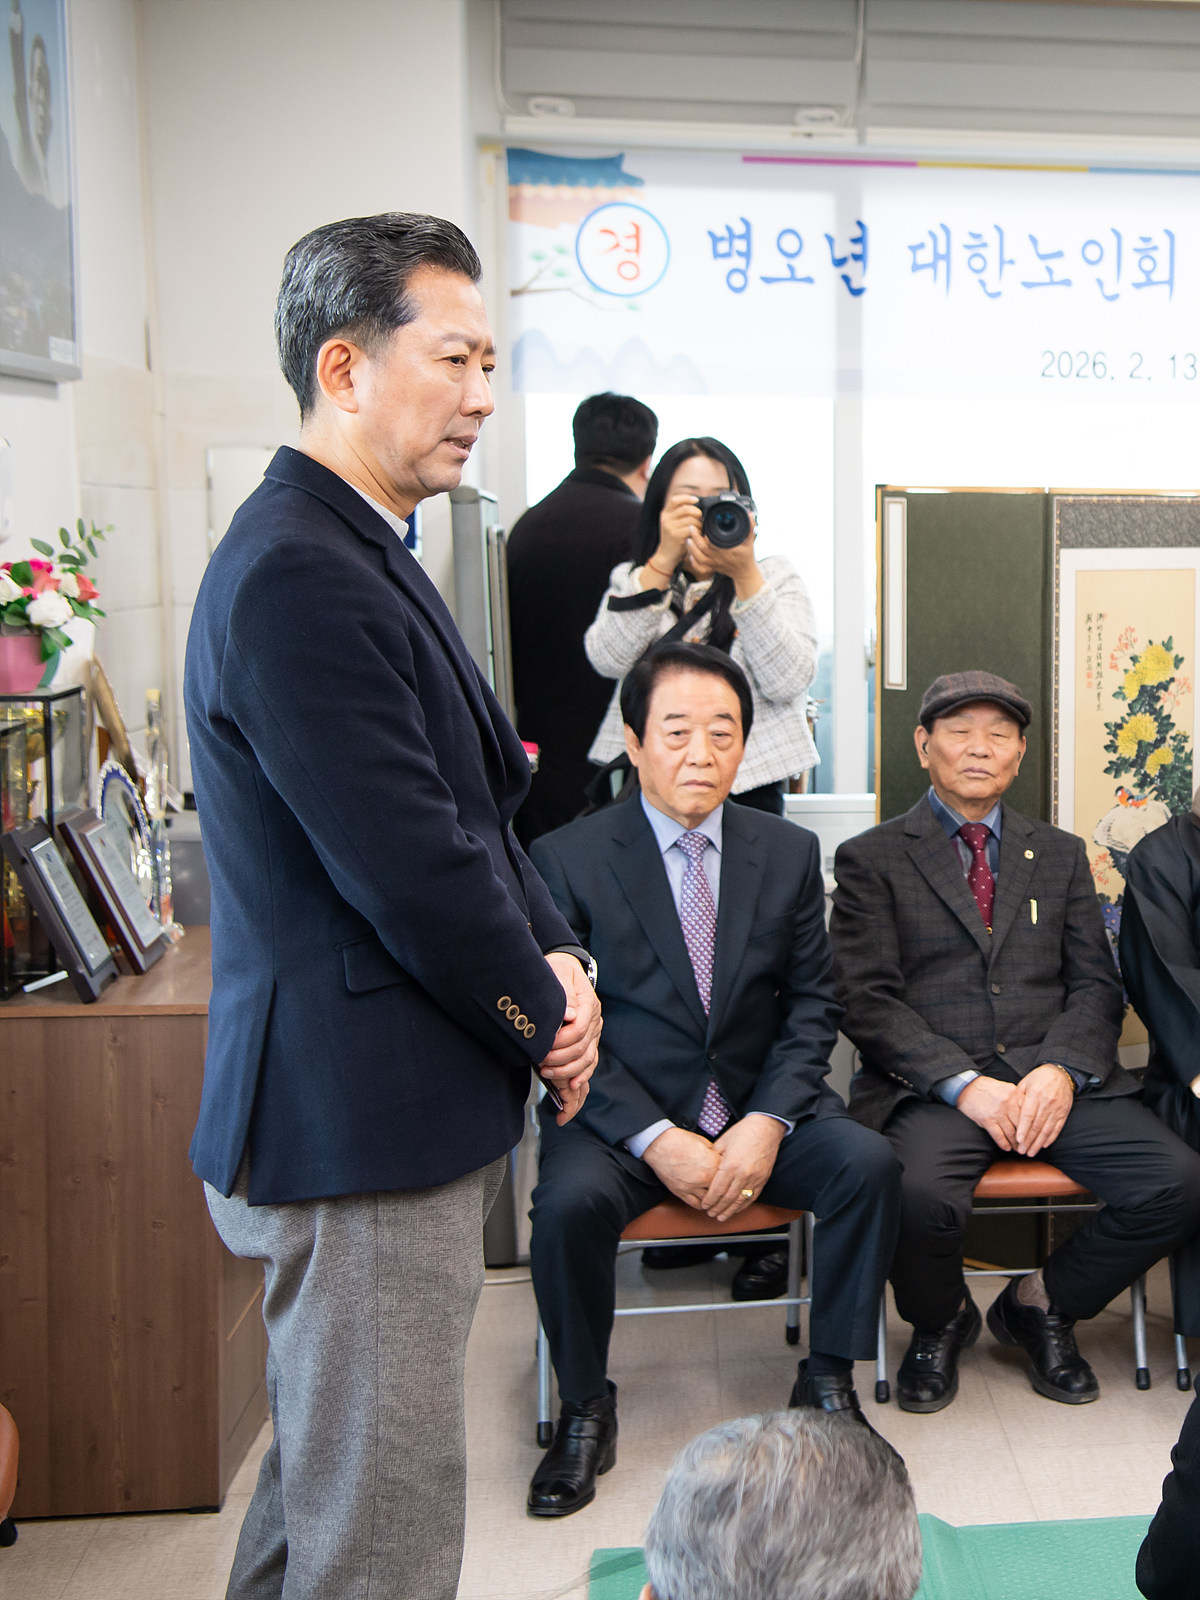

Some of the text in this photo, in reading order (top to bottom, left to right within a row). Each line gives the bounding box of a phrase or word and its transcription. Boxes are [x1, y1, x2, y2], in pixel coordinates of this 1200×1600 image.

[599, 221, 643, 282] 경
[706, 216, 869, 297] 병오년
[907, 222, 1176, 303] 대한노인회
[1040, 350, 1116, 381] 2026.
[1129, 351, 1153, 381] 2.
